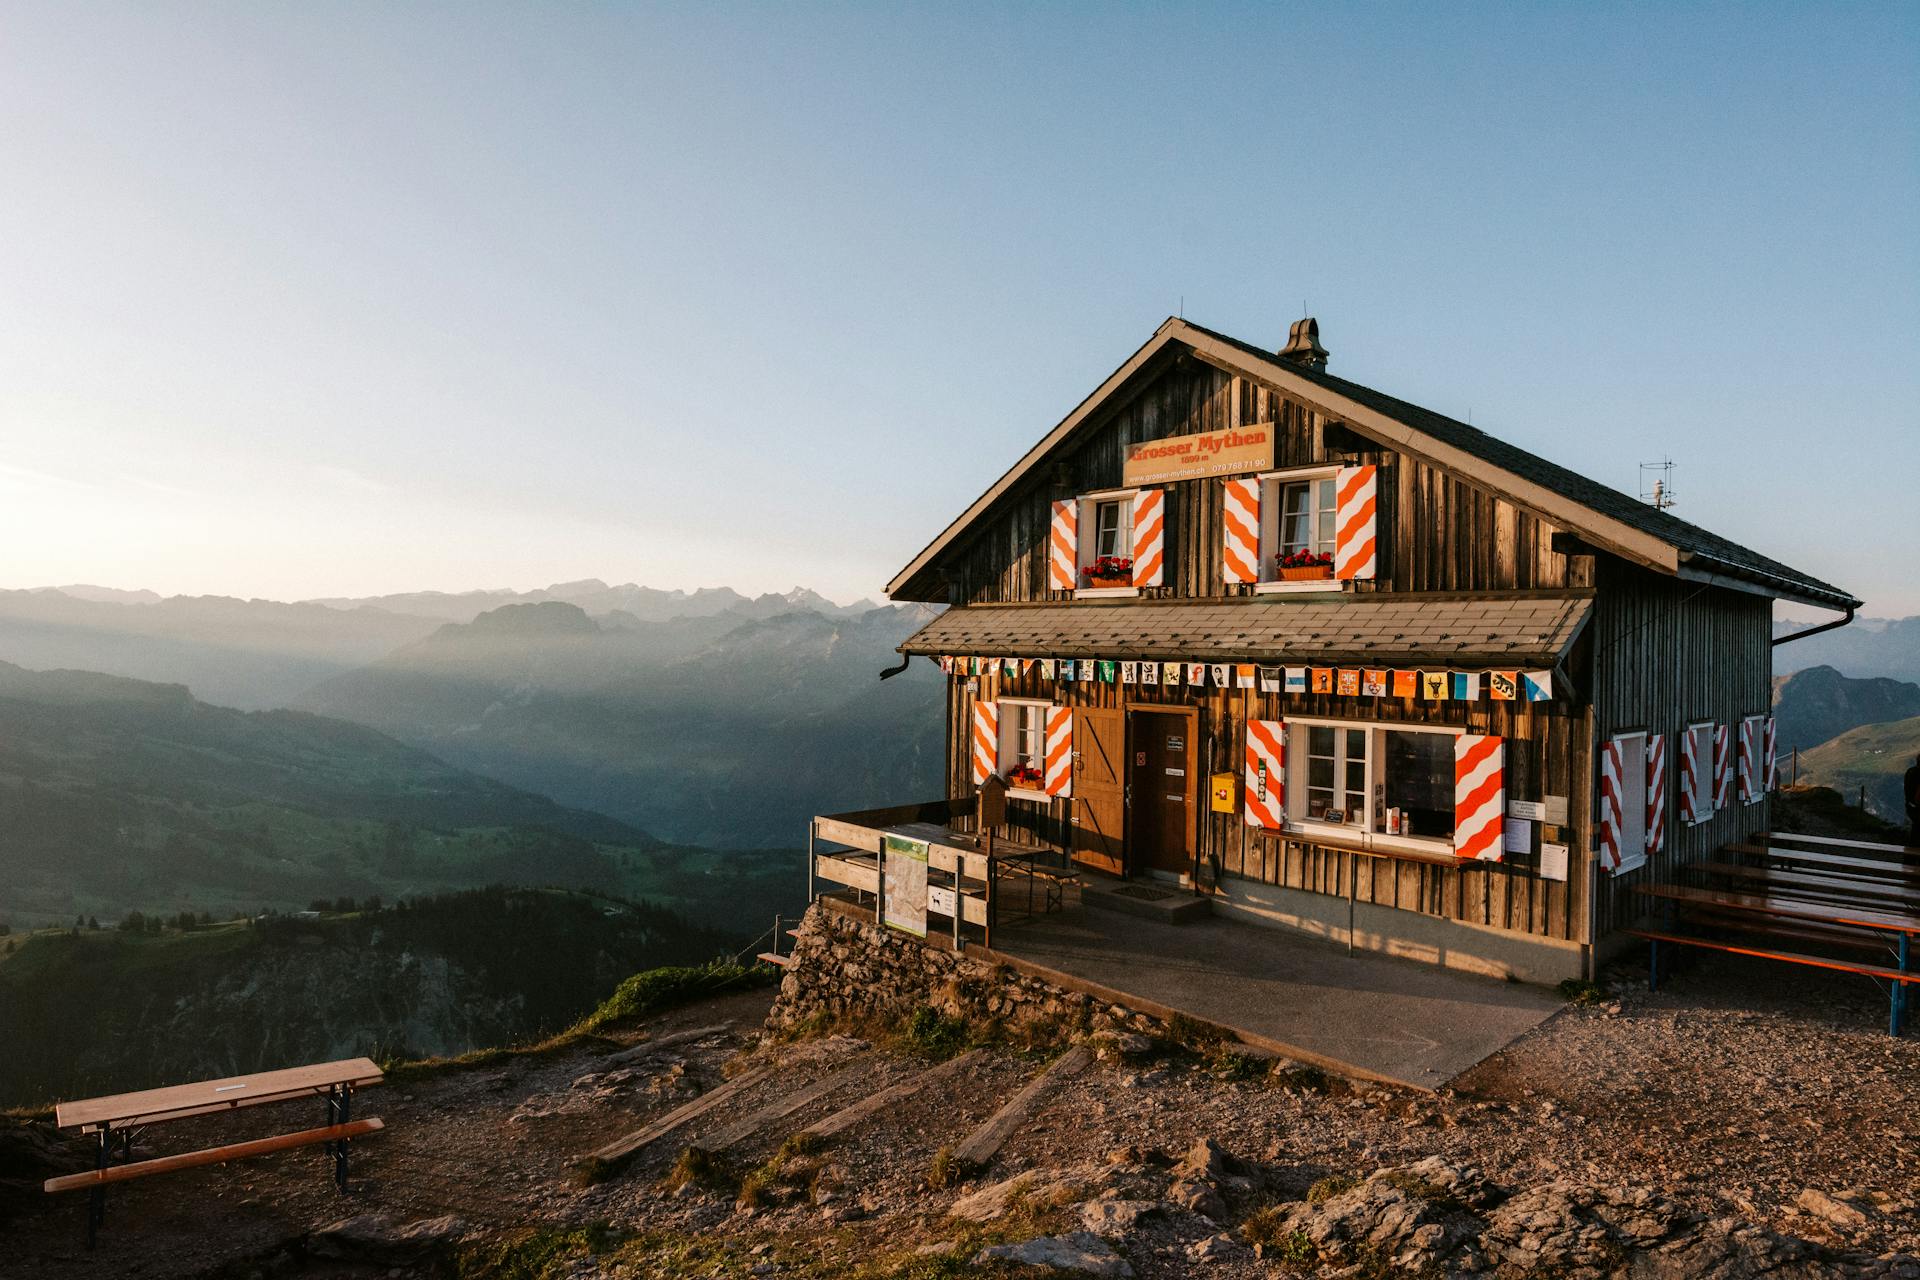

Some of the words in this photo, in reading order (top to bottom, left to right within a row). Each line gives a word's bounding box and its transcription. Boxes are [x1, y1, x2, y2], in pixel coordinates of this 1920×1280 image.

[1130, 442, 1193, 462] Grosser
[1197, 431, 1266, 454] Mythen
[1129, 467, 1205, 482] www.grosser-mythen.ch
[1212, 463, 1227, 472] 079
[1243, 460, 1253, 469] 71
[1254, 458, 1266, 467] 90
